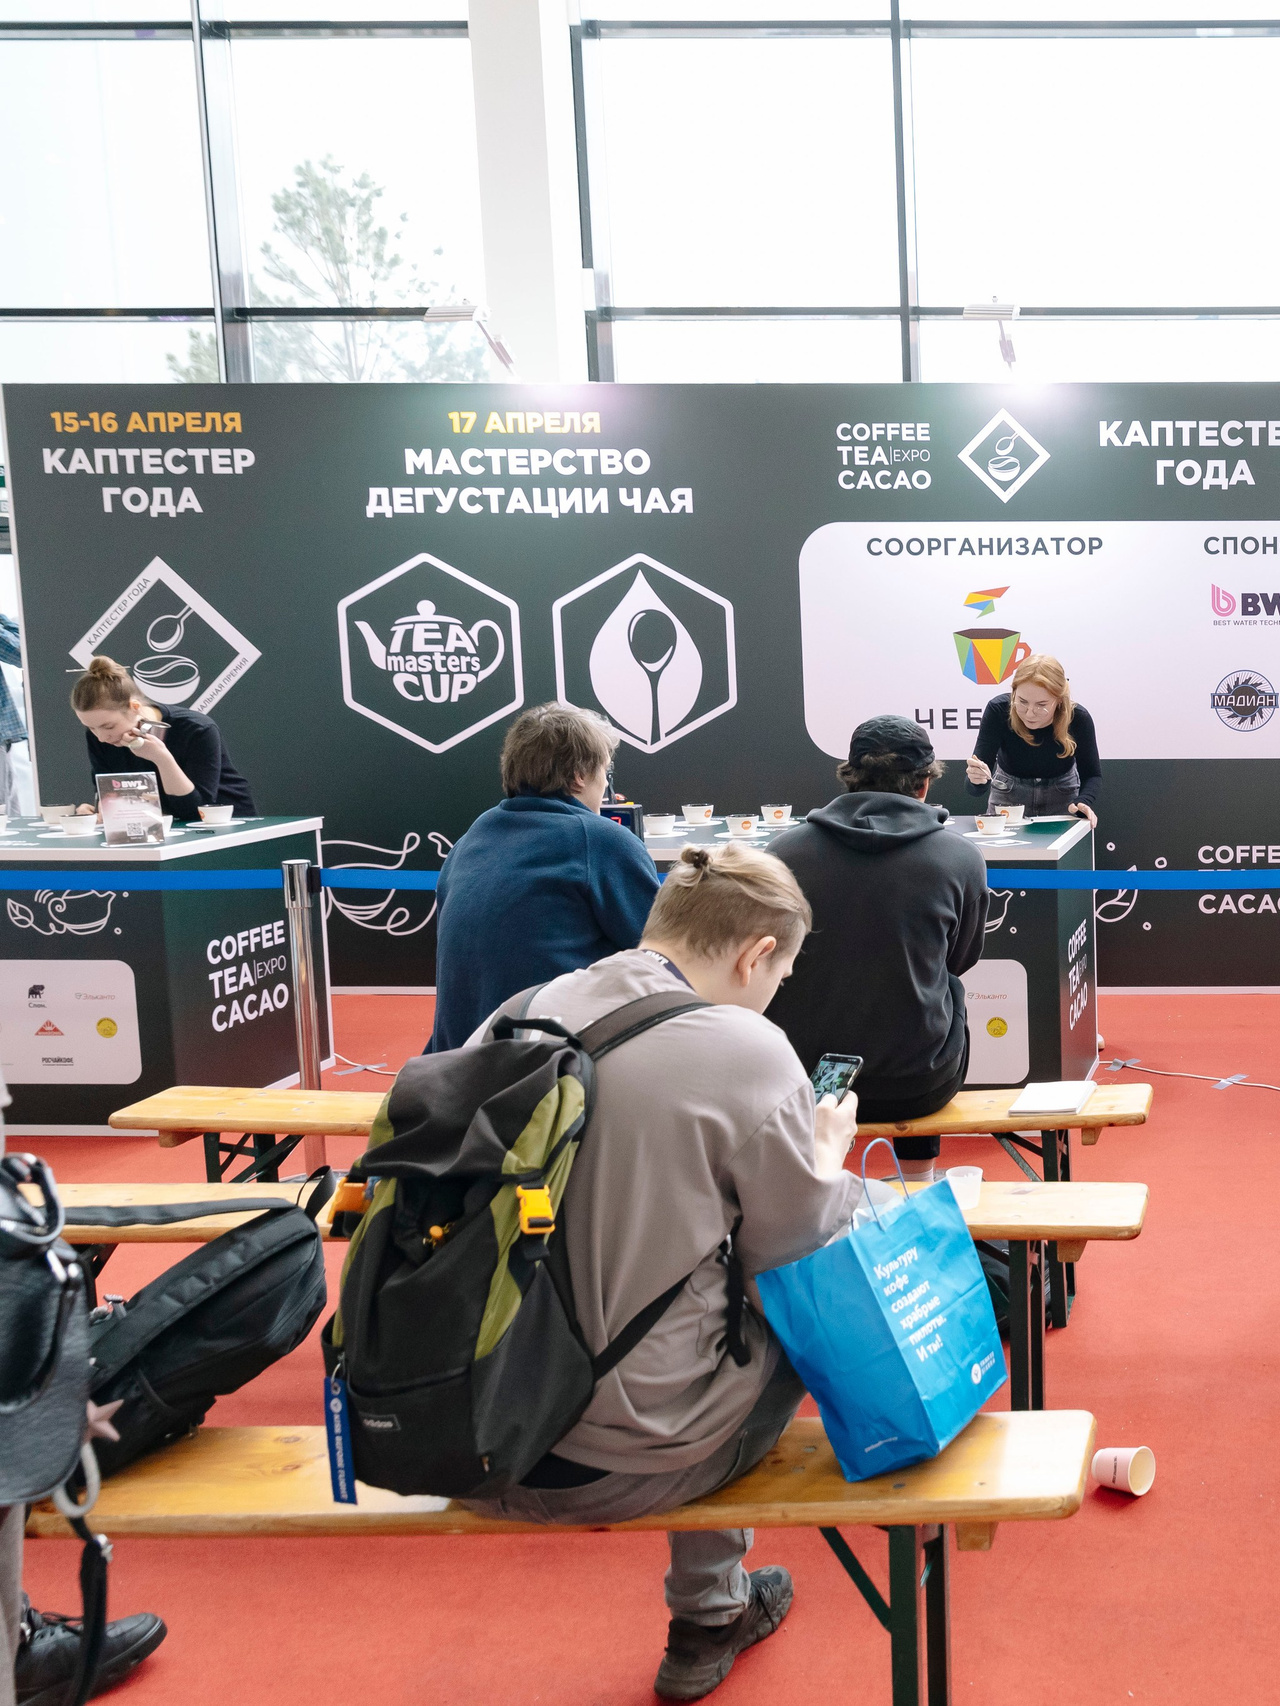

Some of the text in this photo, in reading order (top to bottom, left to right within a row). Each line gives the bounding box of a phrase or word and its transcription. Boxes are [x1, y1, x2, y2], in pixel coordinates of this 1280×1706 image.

[50, 411, 243, 434] 15-16 АПРЕЛЯ
[447, 411, 601, 434] 17 АПРЕЛЯ
[836, 422, 931, 442] COFFEE
[43, 447, 256, 475] КАПТЕСТЕР
[404, 446, 651, 476] МАСТЕРСТВО
[837, 445, 931, 466] TEA EXPO
[837, 469, 932, 490] CACAO
[1156, 459, 1256, 490] ГОДА
[102, 486, 204, 518] ГОДА
[366, 486, 694, 519] ДЕГУСТАЦИИ ЧАЯ
[866, 537, 1103, 557] СООРГАНИЗАТОР
[87, 577, 151, 646] КАПТЕСТЕР ГОДА
[390, 622, 477, 654] TEA
[386, 651, 481, 673] masters
[392, 672, 477, 703] CUP
[1214, 695, 1276, 707] МАДИАН
[915, 708, 982, 730] ЧЕБ
[121, 780, 143, 788] BWT
[206, 920, 286, 965] COFFEE
[1067, 918, 1087, 963] COFFEE
[208, 955, 287, 999] TEA EXPO
[1068, 961, 1080, 997] TEA
[211, 983, 290, 1033] CACAO
[1069, 981, 1088, 1031] CACAO
[873, 1246, 919, 1280] Культуру
[883, 1274, 909, 1296] кофе
[891, 1280, 930, 1313] создают
[900, 1295, 941, 1329] храбрые
[908, 1314, 947, 1346] пилоты.
[915, 1333, 944, 1362] И ты!
